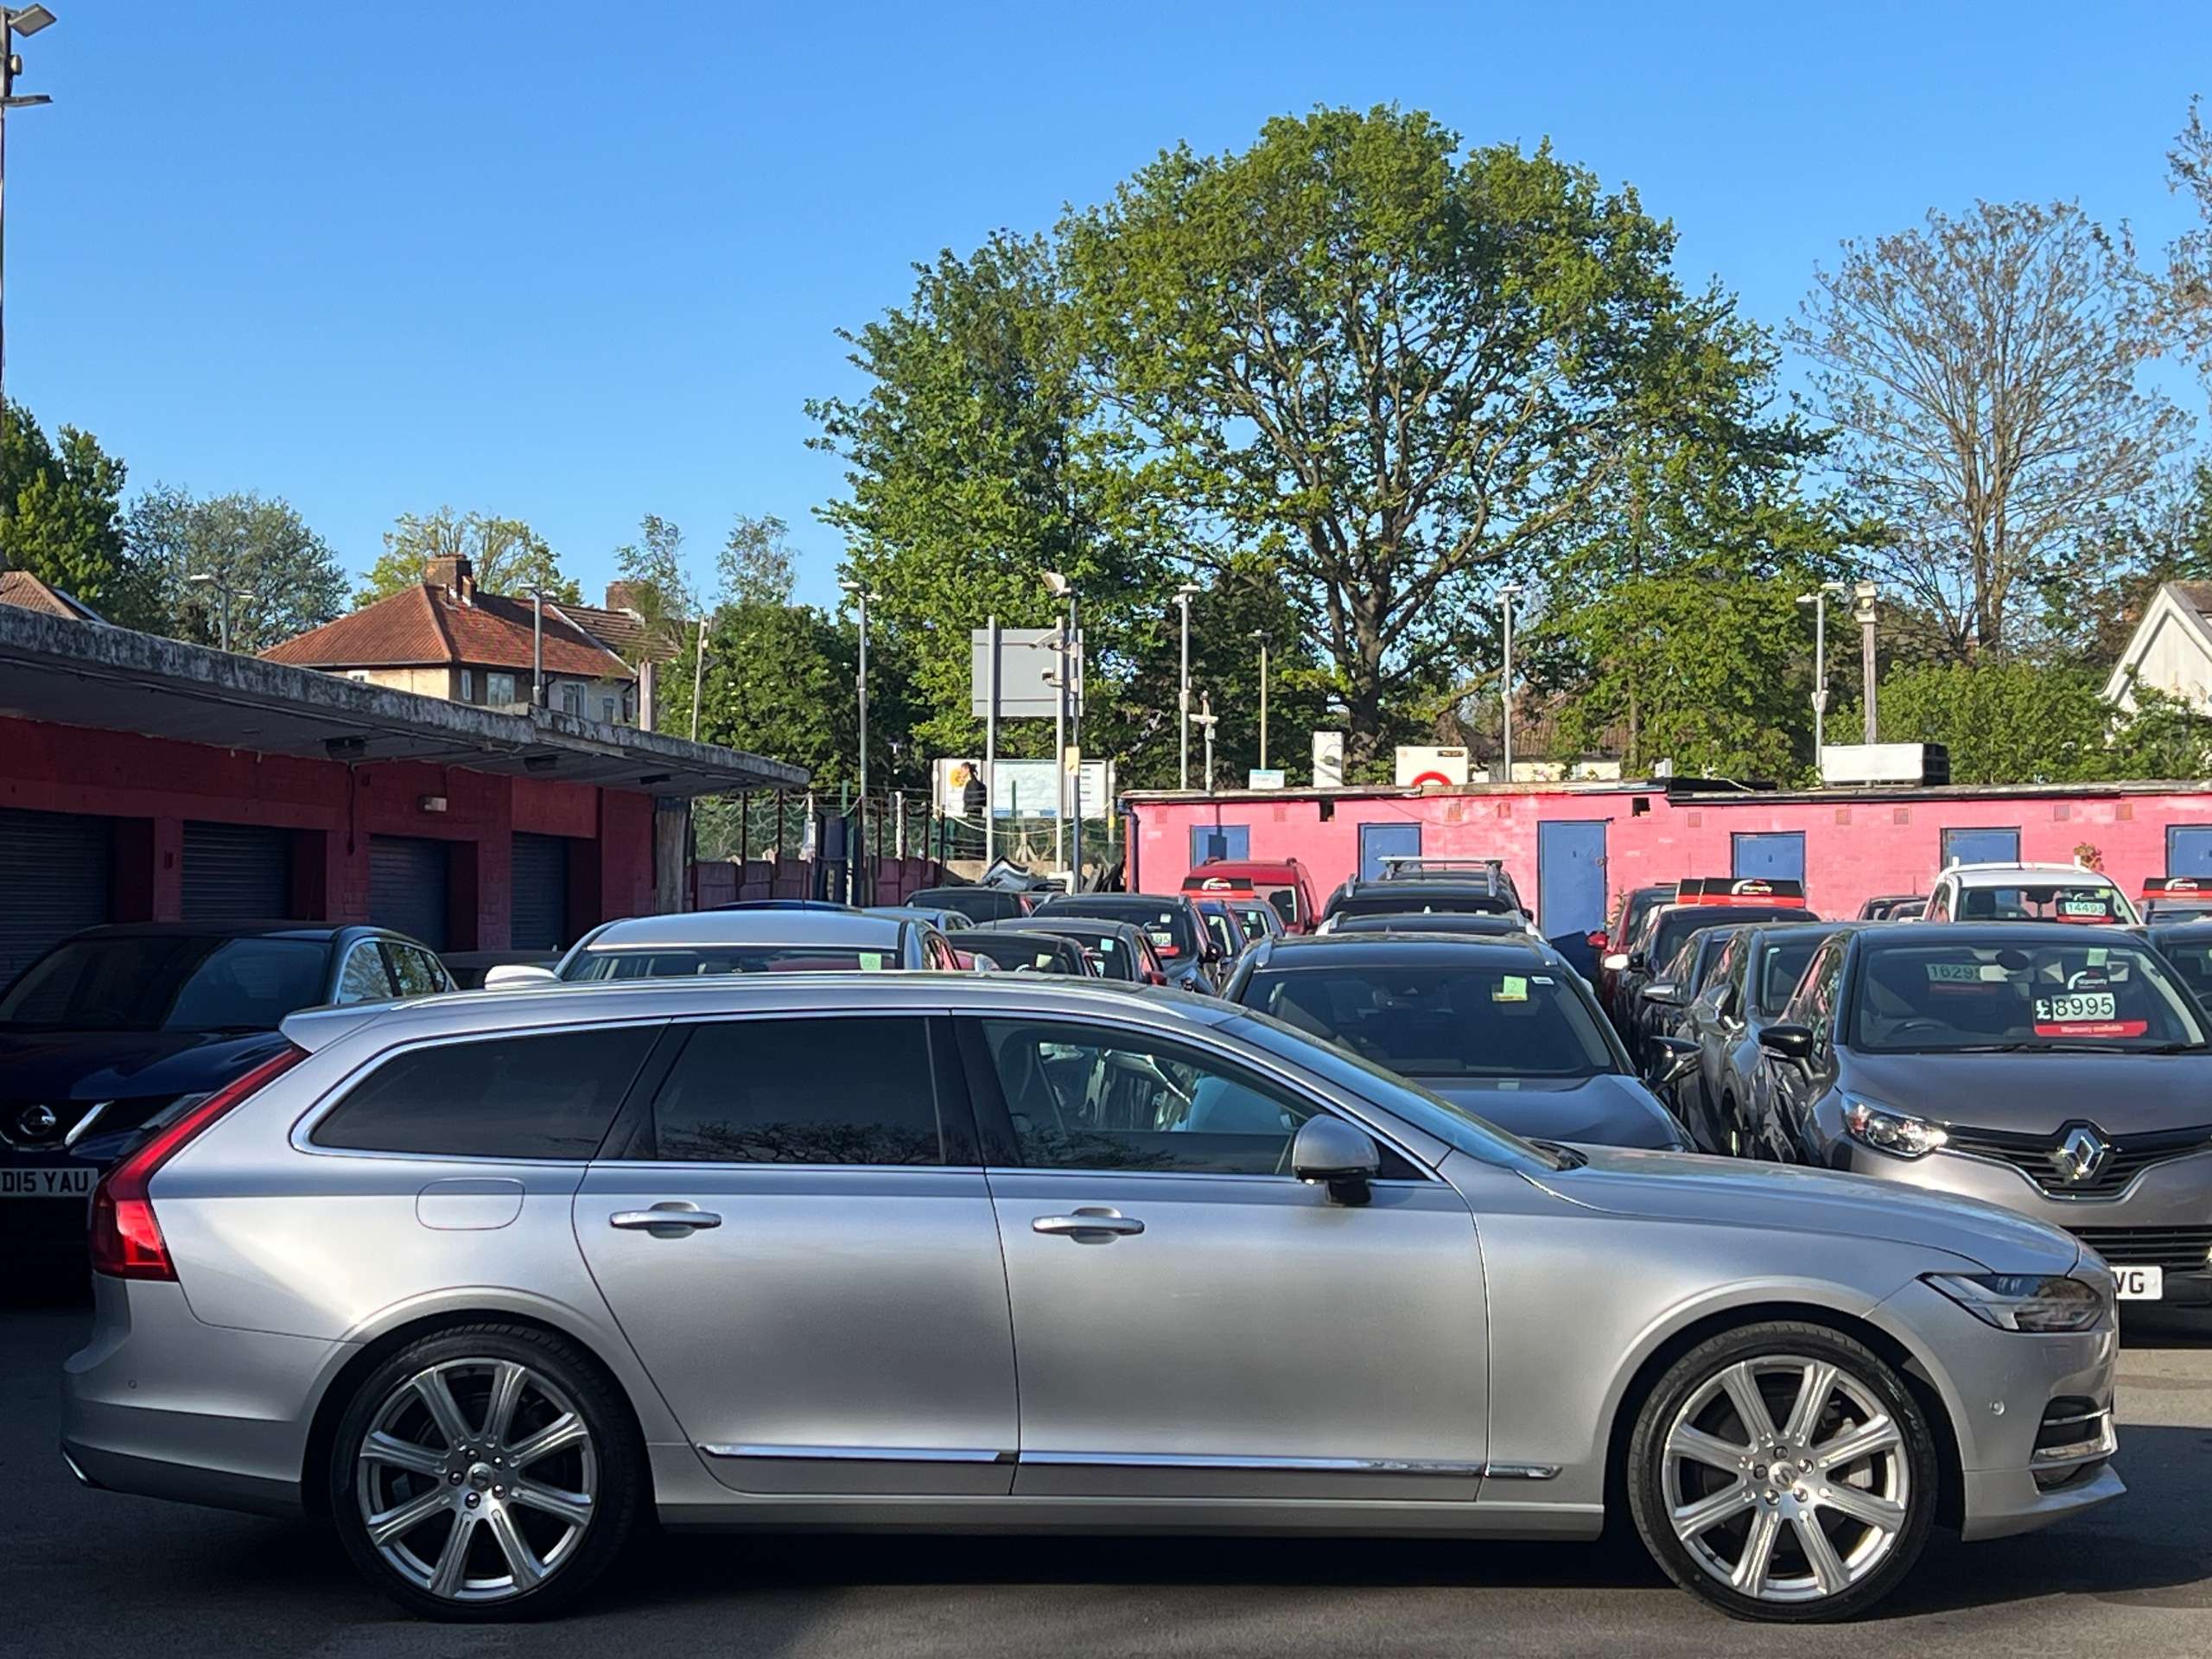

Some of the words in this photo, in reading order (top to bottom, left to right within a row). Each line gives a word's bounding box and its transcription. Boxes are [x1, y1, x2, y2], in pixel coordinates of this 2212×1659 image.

[2036, 997, 2113, 1019] £8995
[2, 1171, 36, 1192] D15
[44, 1171, 89, 1192] YAU
